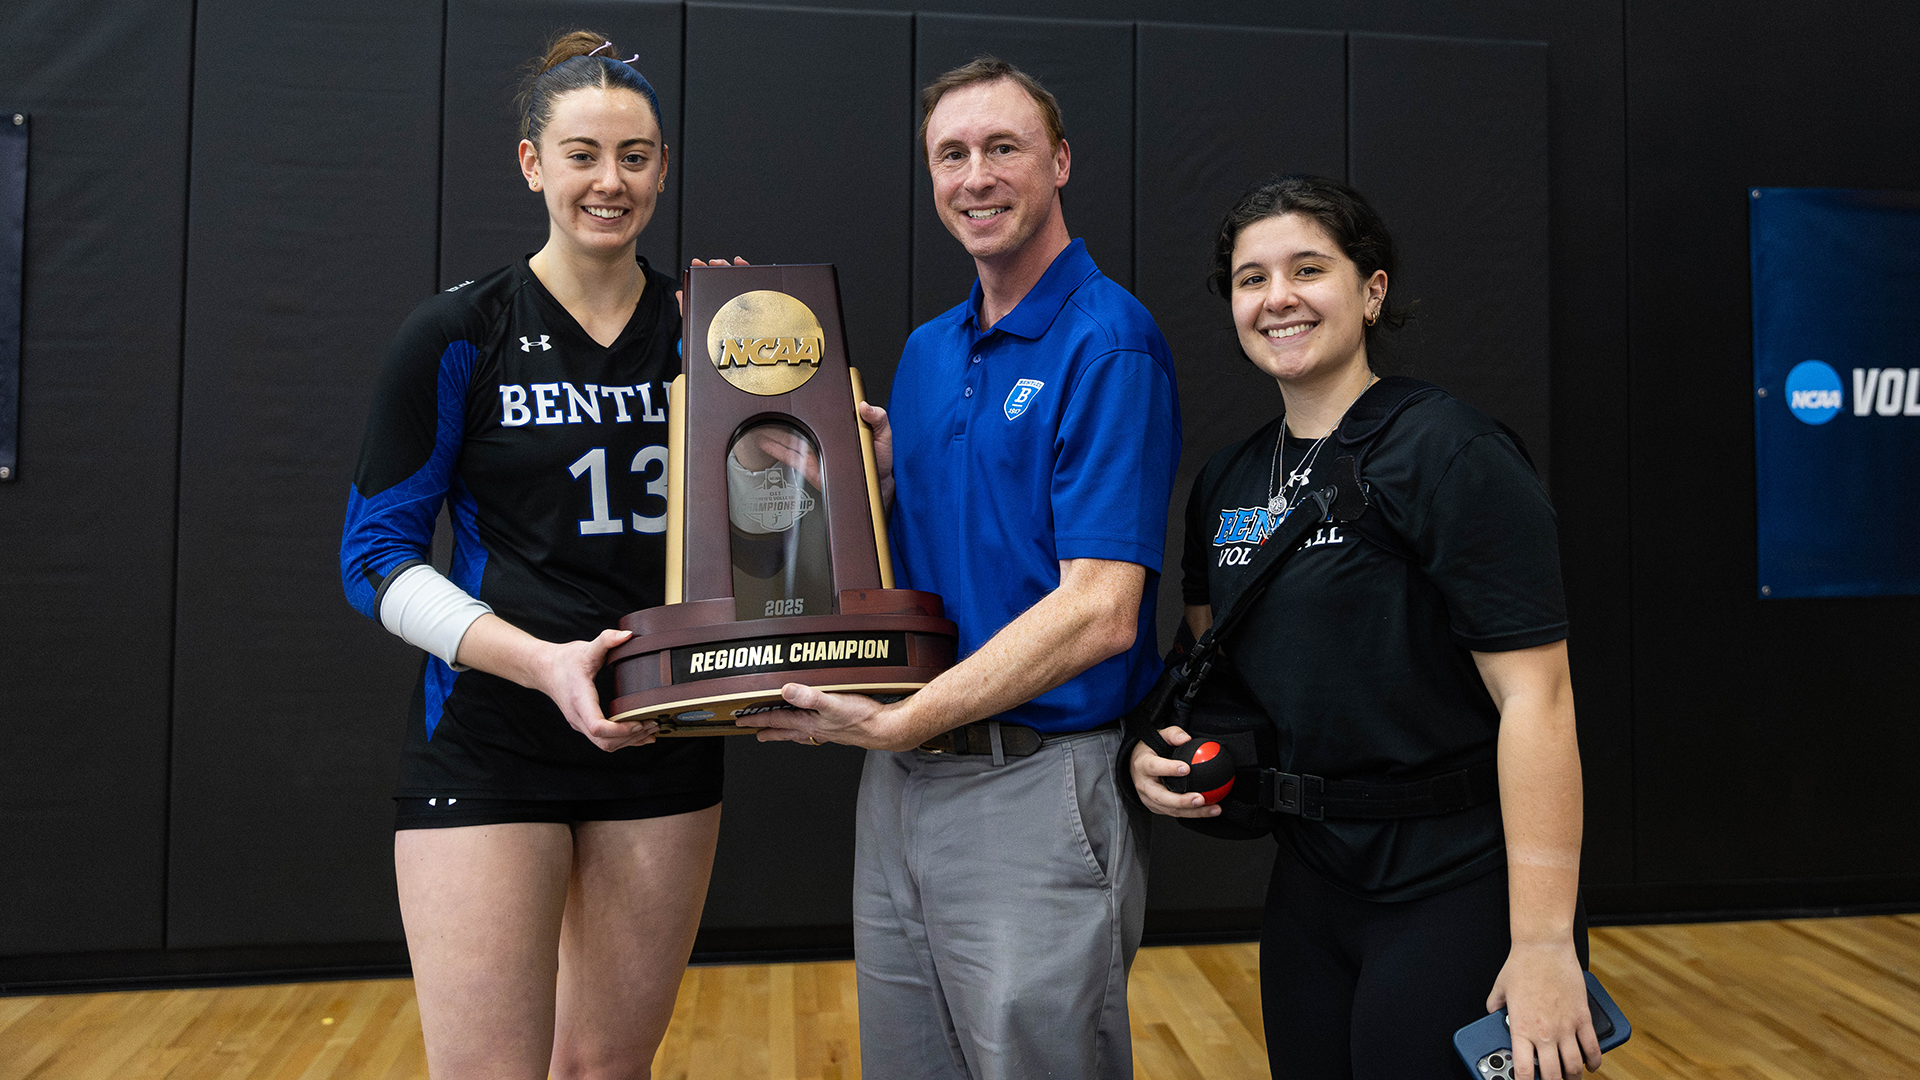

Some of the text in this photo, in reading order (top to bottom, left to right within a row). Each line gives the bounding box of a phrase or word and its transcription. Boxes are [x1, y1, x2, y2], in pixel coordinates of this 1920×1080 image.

[719, 338, 820, 369] NCAA
[499, 381, 671, 427] BENTL
[1014, 387, 1031, 402] B
[1791, 389, 1843, 409] NCAA
[566, 445, 669, 537] 13
[764, 598, 804, 617] 2025
[690, 640, 889, 673] REGIONAL CHAMPION
